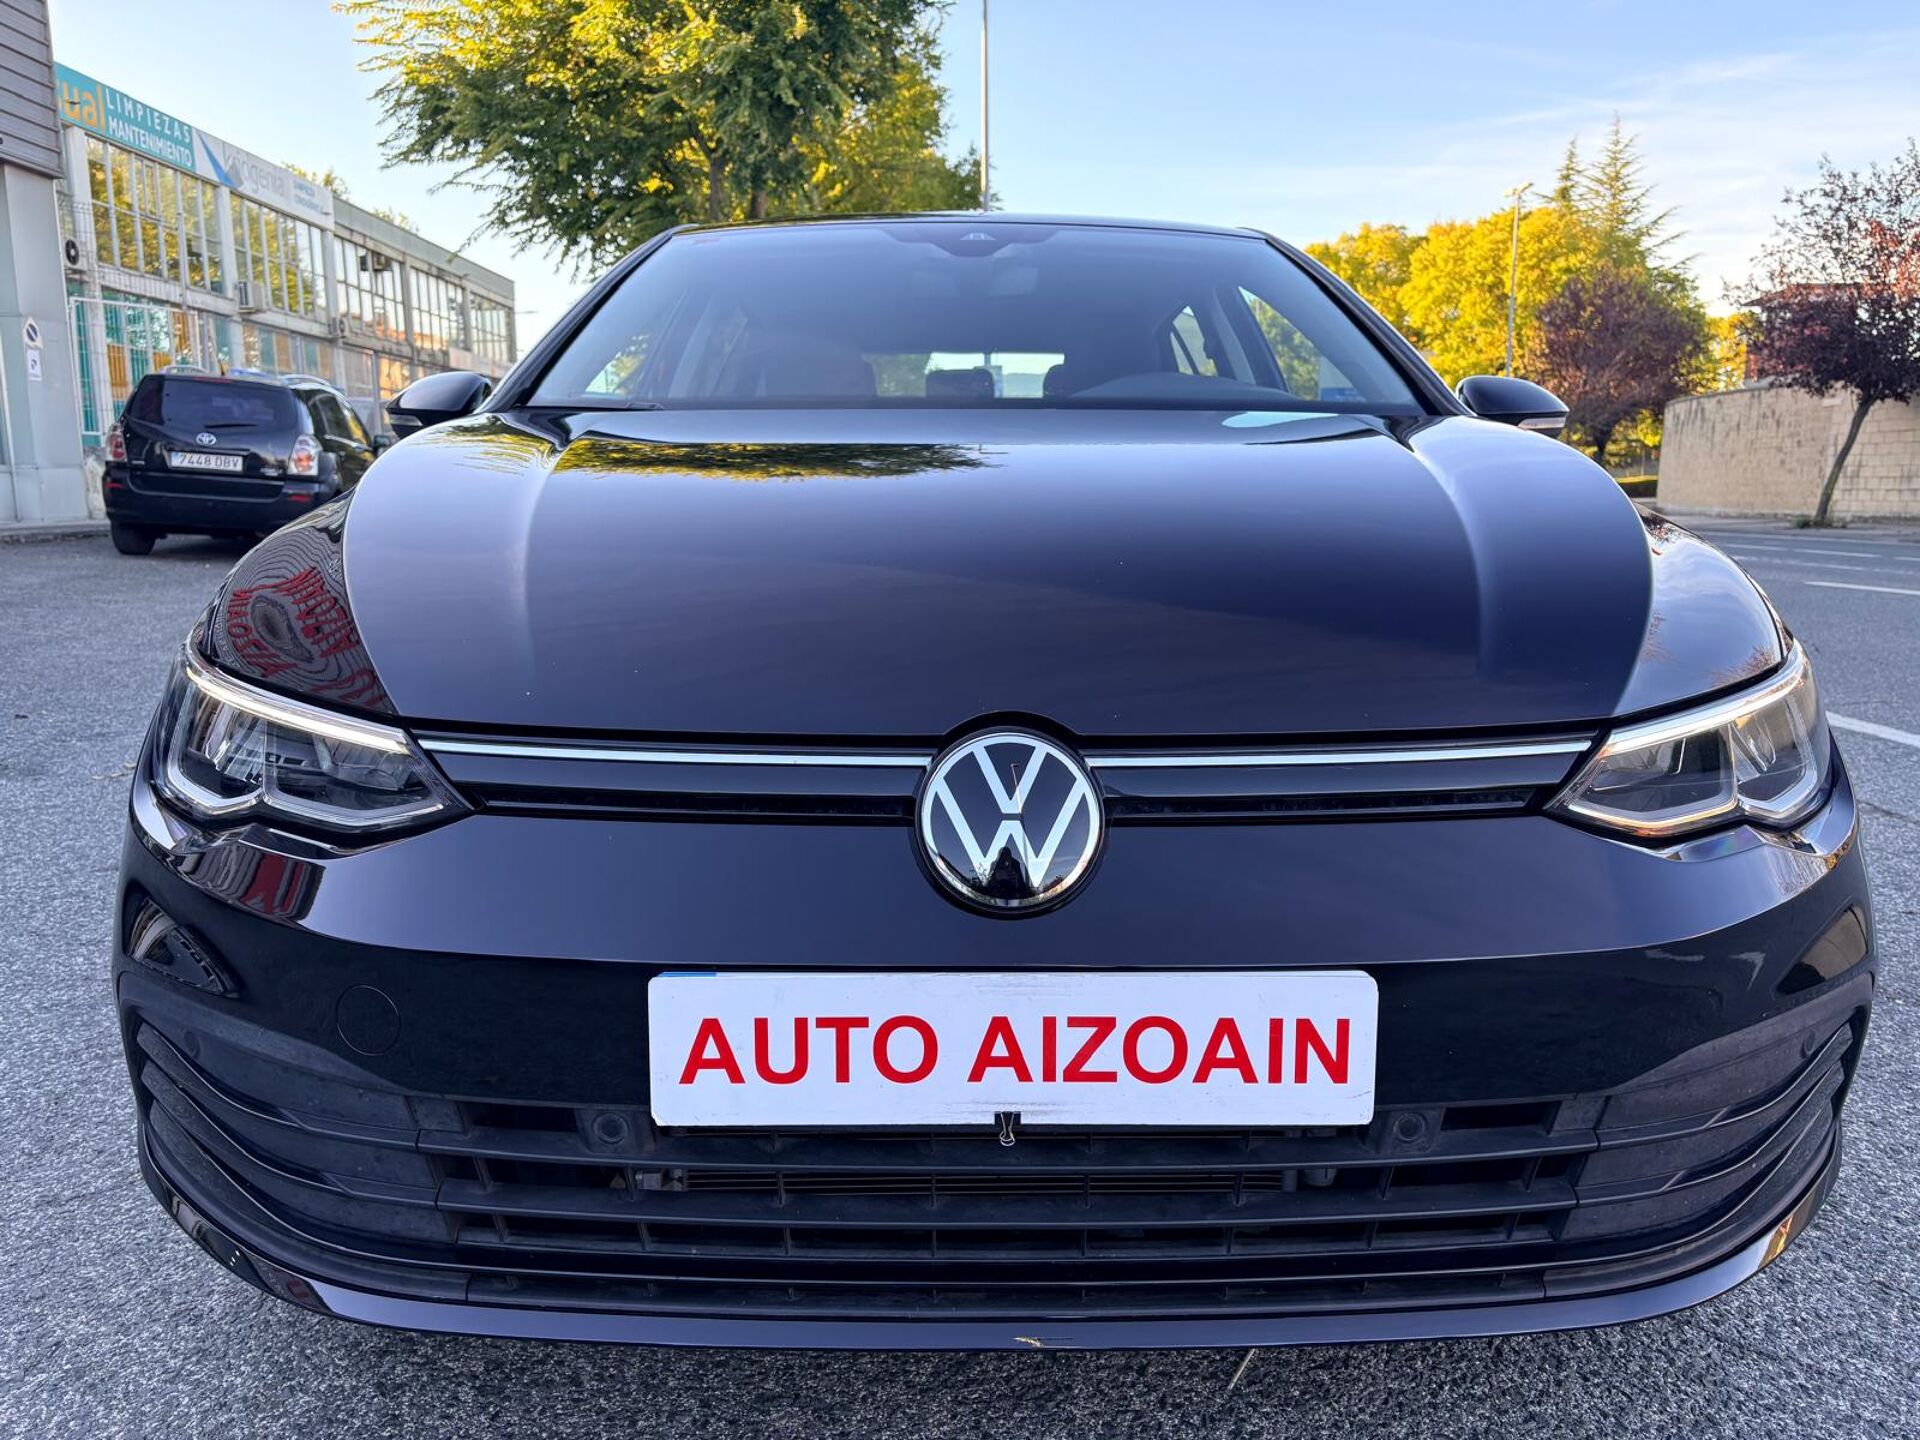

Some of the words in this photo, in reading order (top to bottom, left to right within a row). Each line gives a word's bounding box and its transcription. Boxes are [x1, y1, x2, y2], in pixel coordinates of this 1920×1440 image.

[106, 87, 191, 144] LIMPIEZAS
[108, 114, 192, 167] MANTENIMIENTO
[179, 453, 211, 466] 7448
[678, 1015, 939, 1085] AUTO
[966, 1015, 1351, 1085] AIZOAIN
